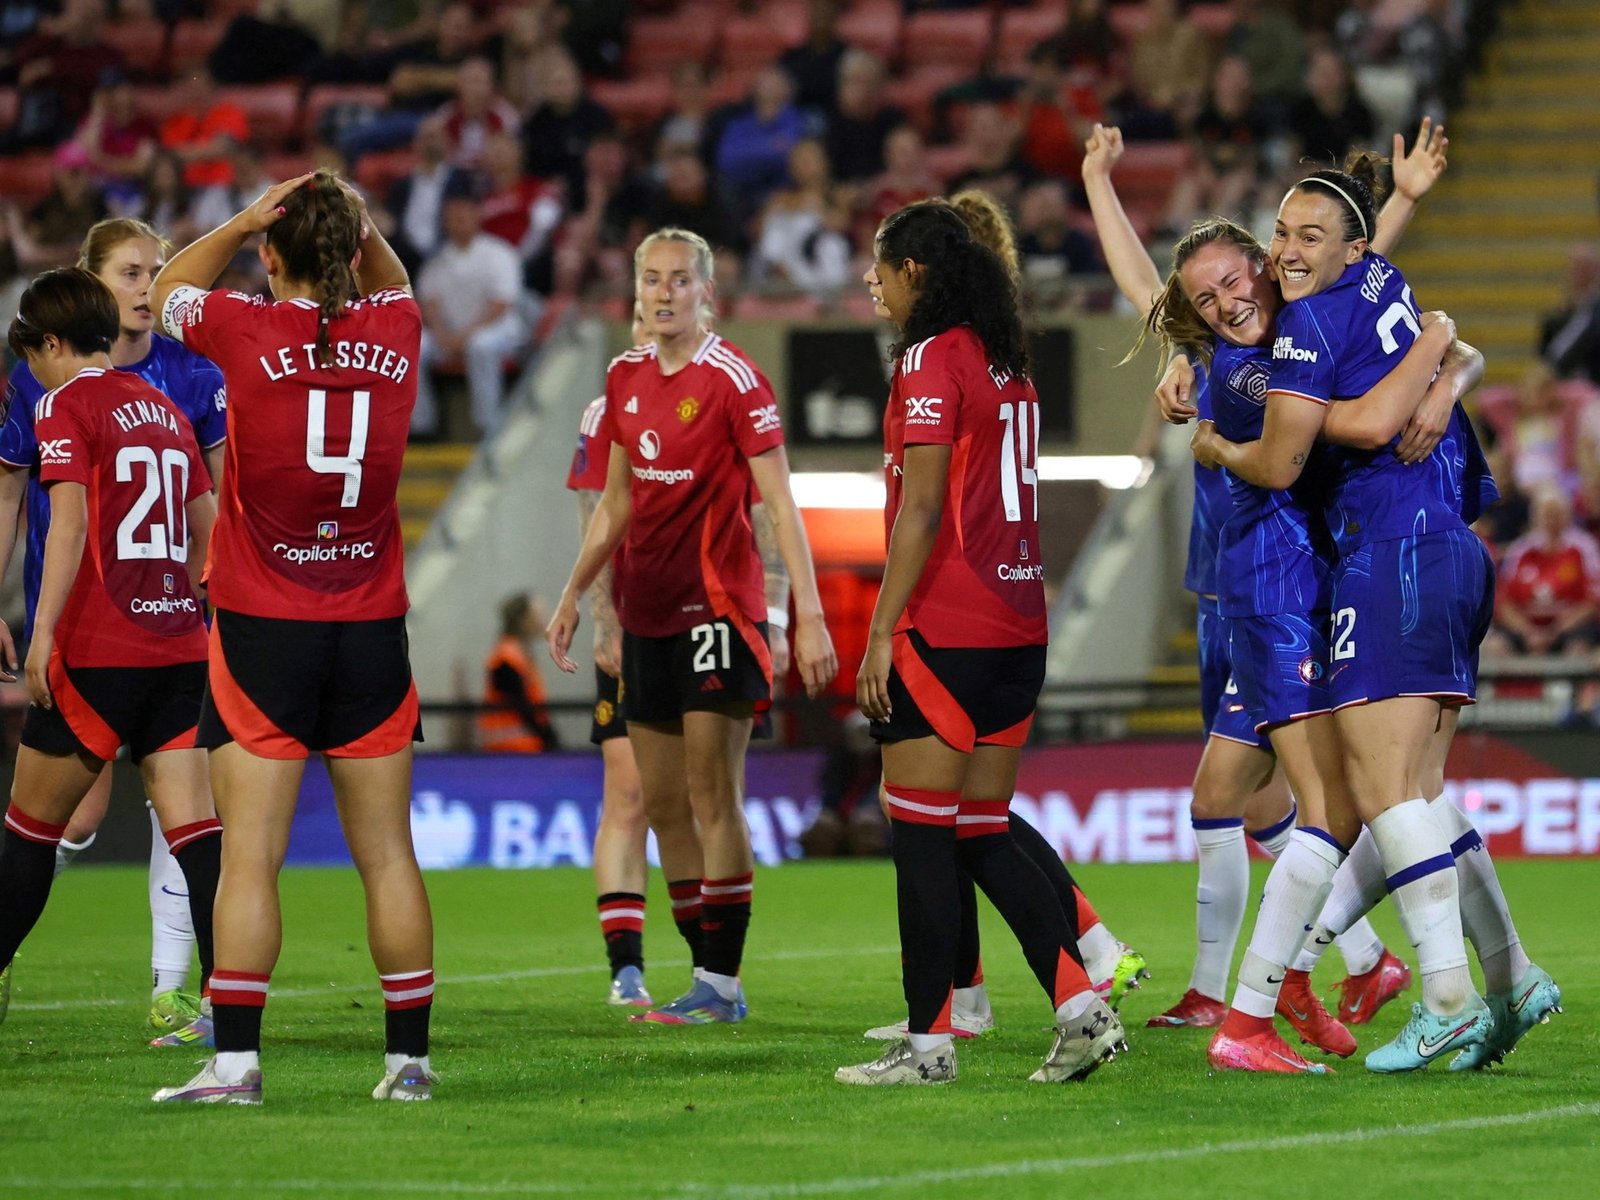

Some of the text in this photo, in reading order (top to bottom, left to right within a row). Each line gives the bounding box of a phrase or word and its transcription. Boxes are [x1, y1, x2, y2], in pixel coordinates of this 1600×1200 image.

[259, 341, 409, 384] LE TSSIER
[1273, 336, 1293, 348] LIVE
[112, 400, 180, 437] HINATA
[38, 438, 72, 459] XC
[305, 389, 371, 508] 4
[999, 401, 1040, 522] 14
[115, 446, 189, 563] 20
[690, 622, 731, 673] 21
